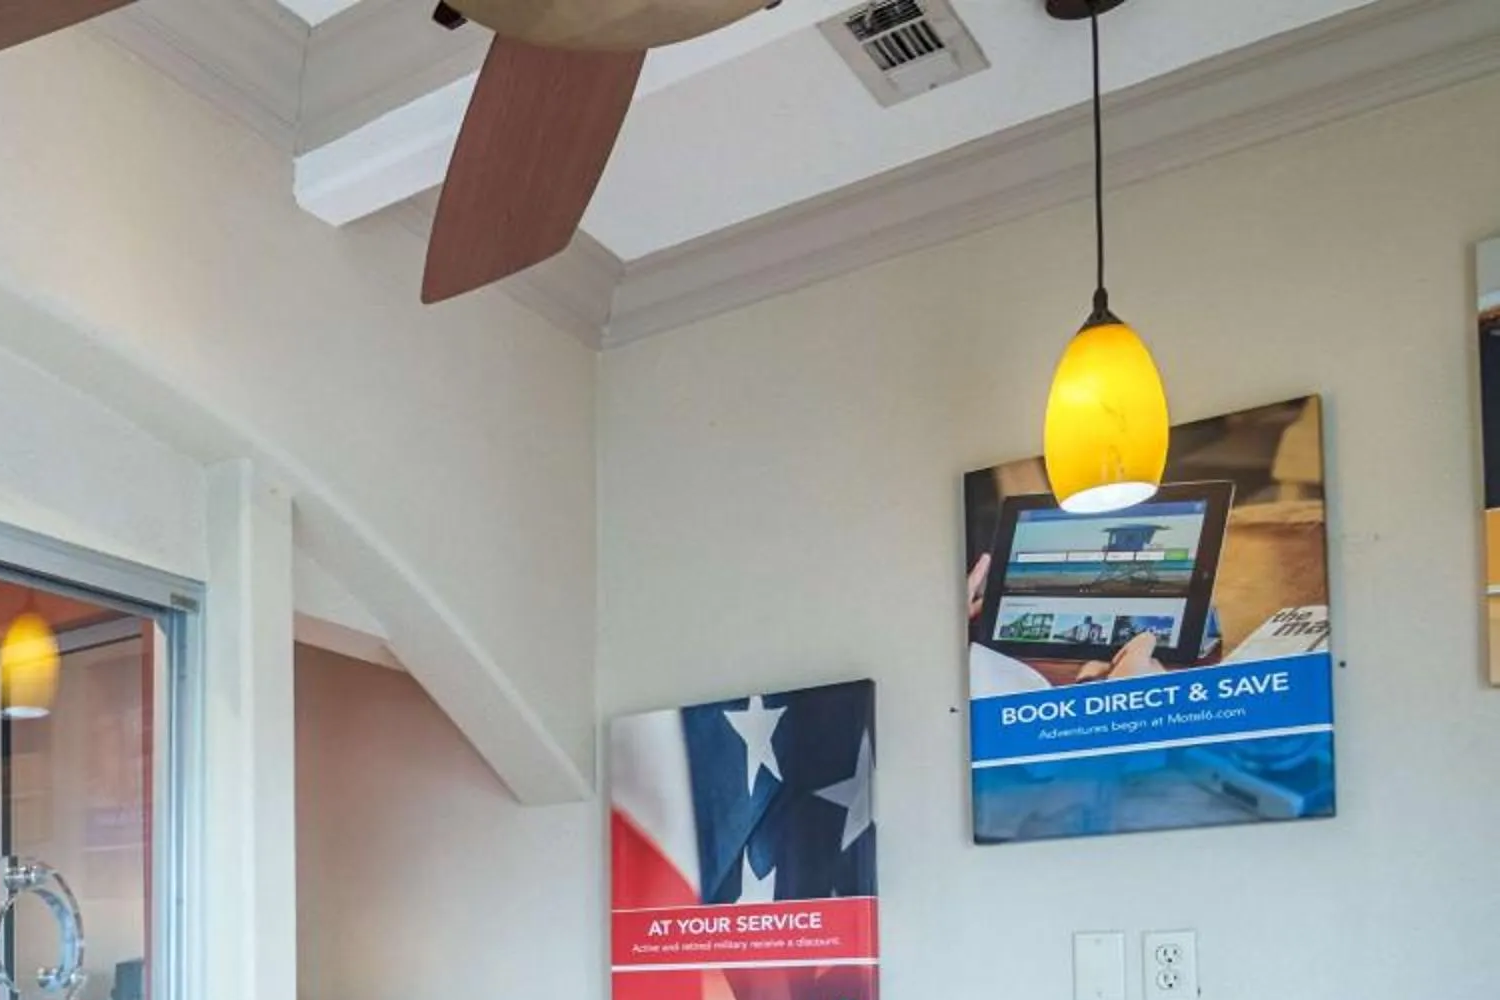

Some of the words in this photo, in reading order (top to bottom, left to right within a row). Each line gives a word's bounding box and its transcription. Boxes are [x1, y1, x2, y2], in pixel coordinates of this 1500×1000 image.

[1001, 700, 1077, 726] BOOK
[1085, 685, 1180, 716] DIRECT
[1188, 682, 1208, 702] &
[1218, 671, 1290, 699] SAVE
[1037, 724, 1109, 740] Adventures
[1111, 718, 1147, 734] begin
[1151, 717, 1164, 728] at
[1167, 706, 1247, 724] Motel6.com
[648, 919, 672, 936] AT
[676, 917, 730, 935] YOUR
[736, 912, 823, 933] SERVICE
